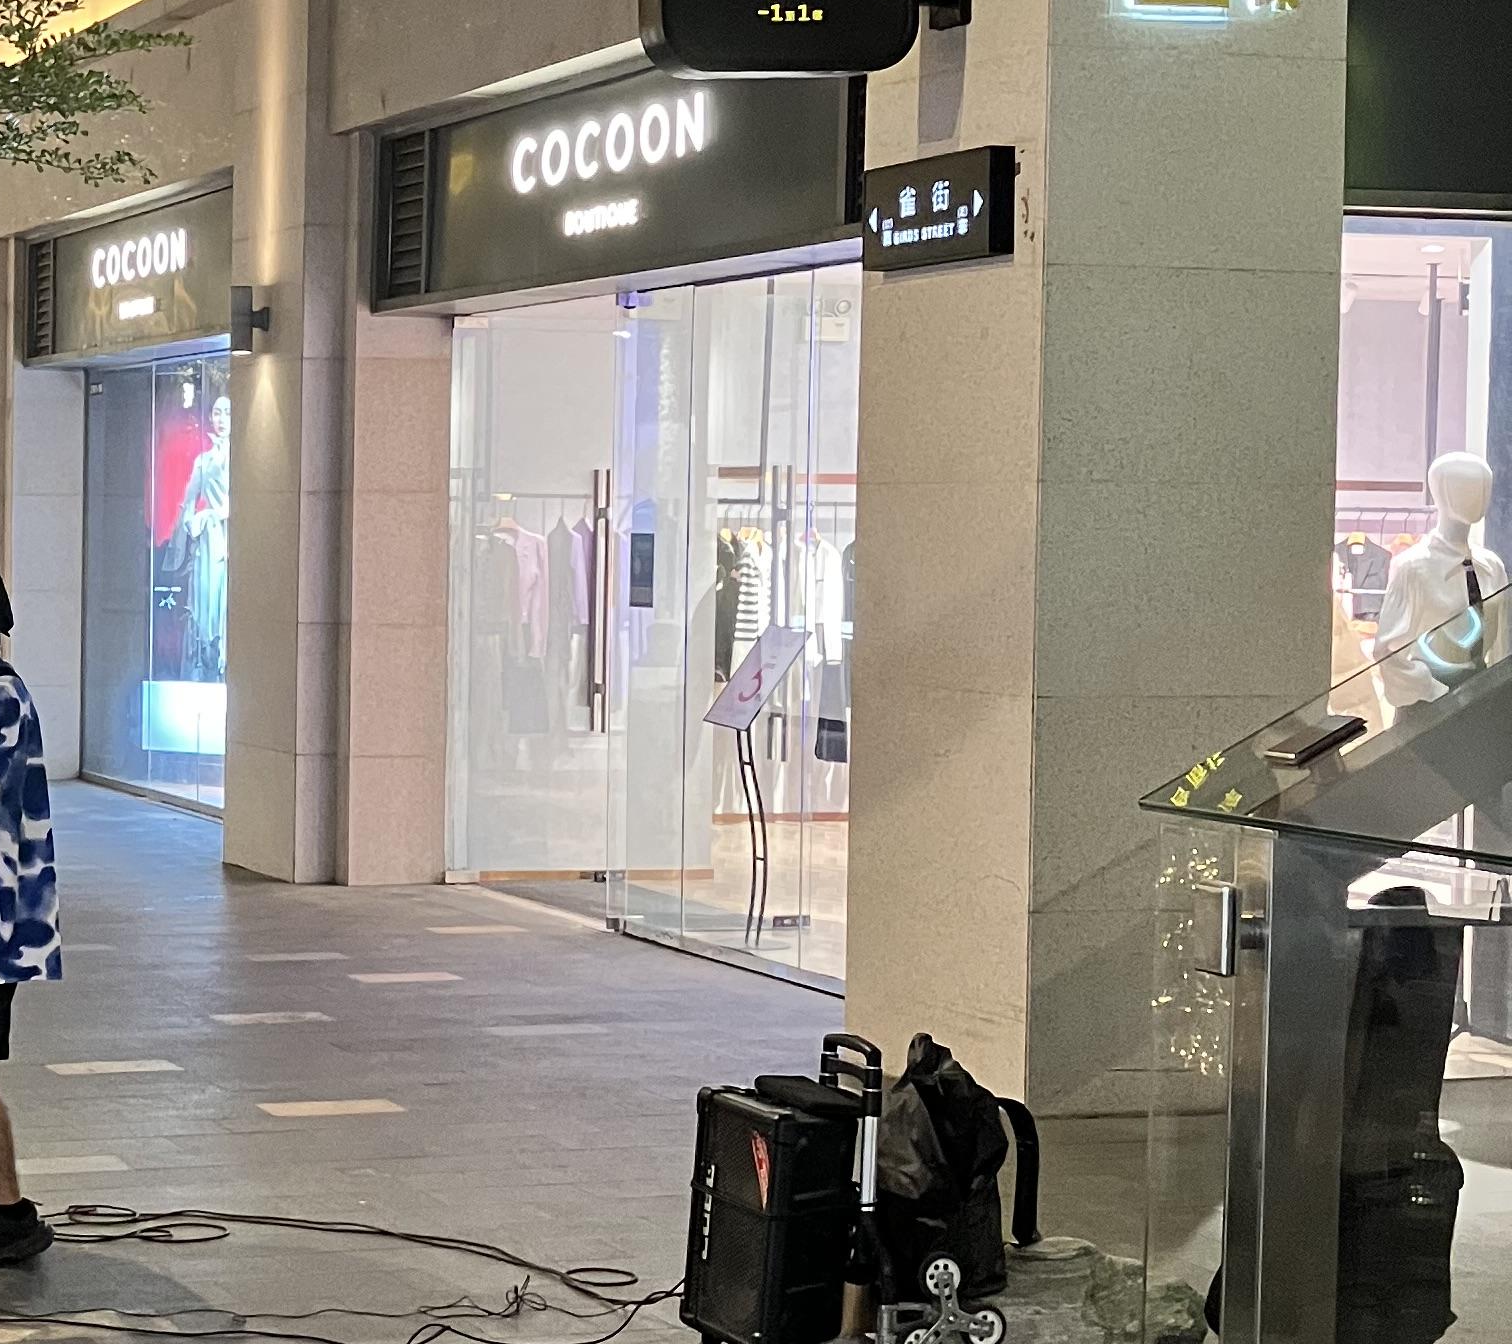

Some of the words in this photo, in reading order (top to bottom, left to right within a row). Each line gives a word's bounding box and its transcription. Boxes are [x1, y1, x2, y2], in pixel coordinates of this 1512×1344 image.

[757, 2, 824, 23] -11
[511, 90, 706, 195] COCOON
[920, 221, 956, 241] STREET
[91, 227, 187, 289] COCOON
